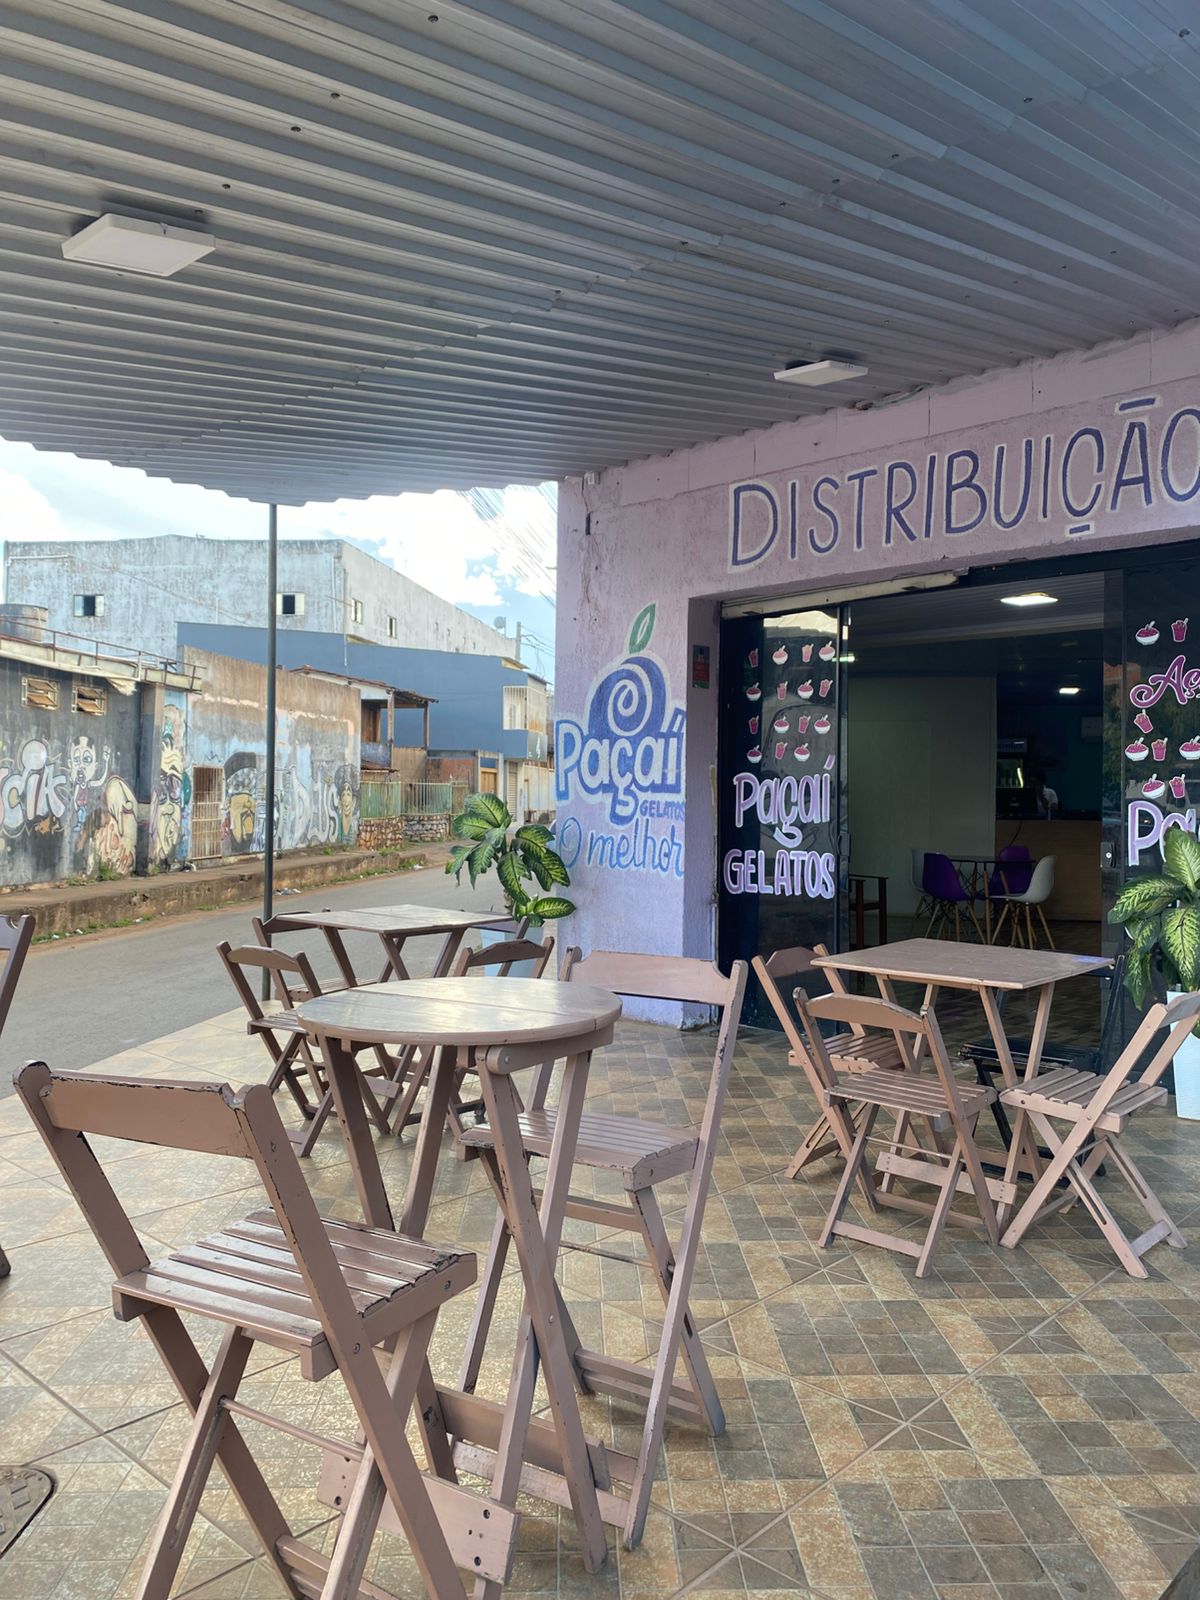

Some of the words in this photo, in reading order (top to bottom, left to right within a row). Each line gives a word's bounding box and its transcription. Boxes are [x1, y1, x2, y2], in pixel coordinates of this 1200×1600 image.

[1130, 655, 1200, 705] Aç
[732, 754, 835, 848] Paçaí
[559, 817, 581, 869] O
[588, 818, 685, 877] melhor
[724, 849, 836, 899] GELATOS
